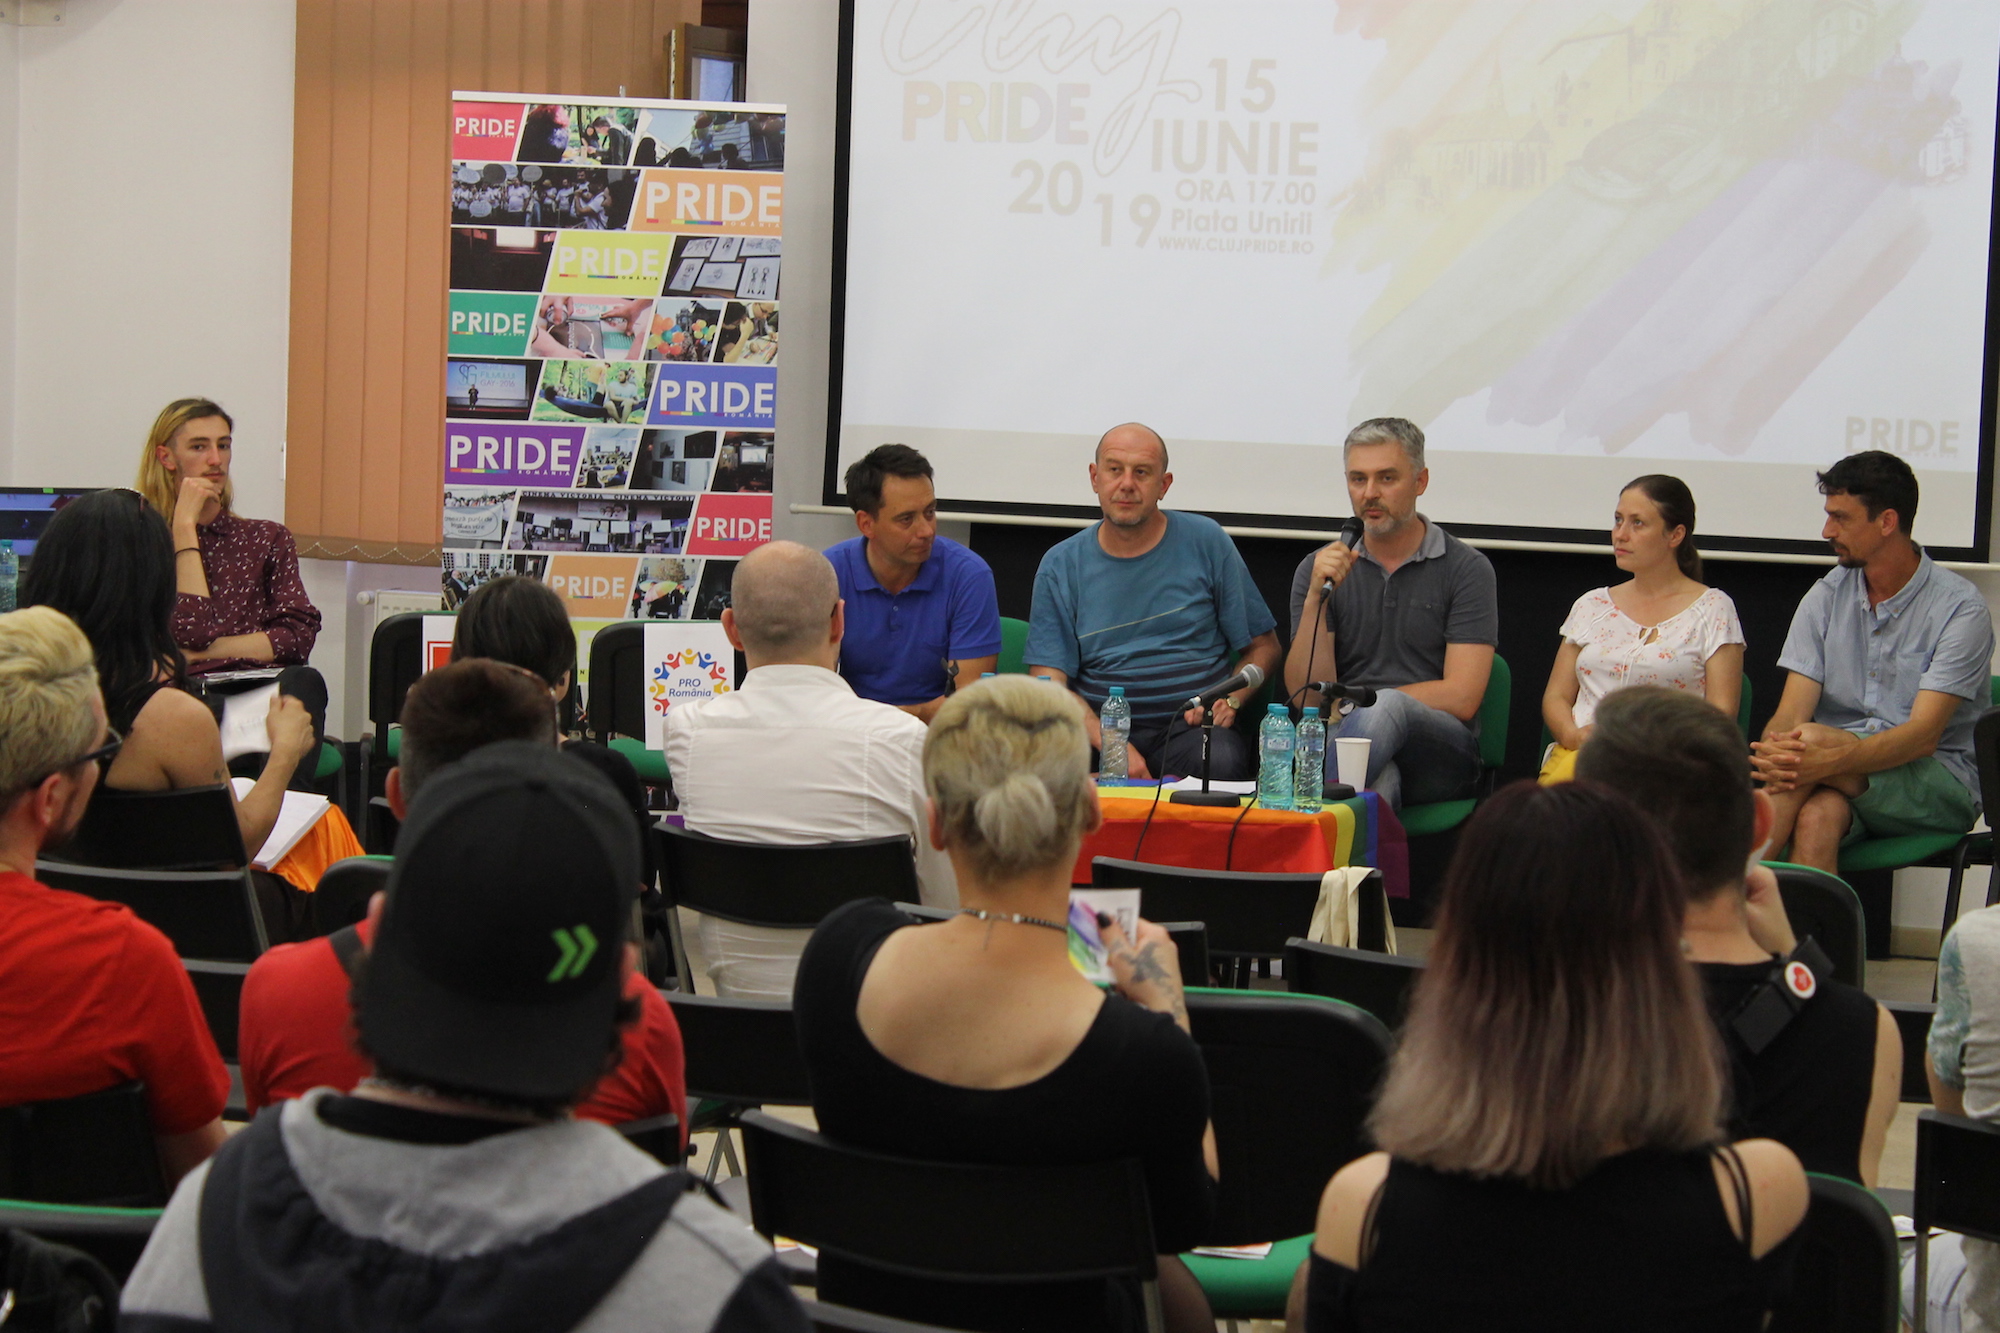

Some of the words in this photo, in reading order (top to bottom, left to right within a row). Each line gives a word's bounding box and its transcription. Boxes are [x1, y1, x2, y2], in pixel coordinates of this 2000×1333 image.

[1207, 57, 1277, 113] 15
[455, 117, 515, 136] PRIDE
[901, 80, 1091, 145] PRIDE
[1151, 119, 1319, 176] IUNIE
[646, 181, 781, 223] PRIDE
[1007, 158, 1083, 216] 20
[1094, 192, 1162, 249] 19
[1175, 178, 1235, 202] ORA
[1247, 180, 1316, 206] 17.00
[1171, 208, 1238, 233] Piata
[1248, 210, 1313, 236] Unirii
[1158, 236, 1315, 255] WWW.CLUJPRIDE.RO
[558, 246, 659, 276] PRIDE
[452, 311, 526, 334] PRIDE
[660, 380, 774, 414] PRIDE
[1845, 416, 1960, 454] PRIDE
[450, 435, 572, 472] PRIDE
[522, 490, 556, 498] CINEMA
[560, 492, 604, 500] VICTORIA
[614, 493, 648, 501] CINEMA
[697, 516, 772, 539] PRIDE
[552, 575, 625, 598] PRIDE
[668, 688, 712, 698] România
[678, 678, 702, 688] PRO
